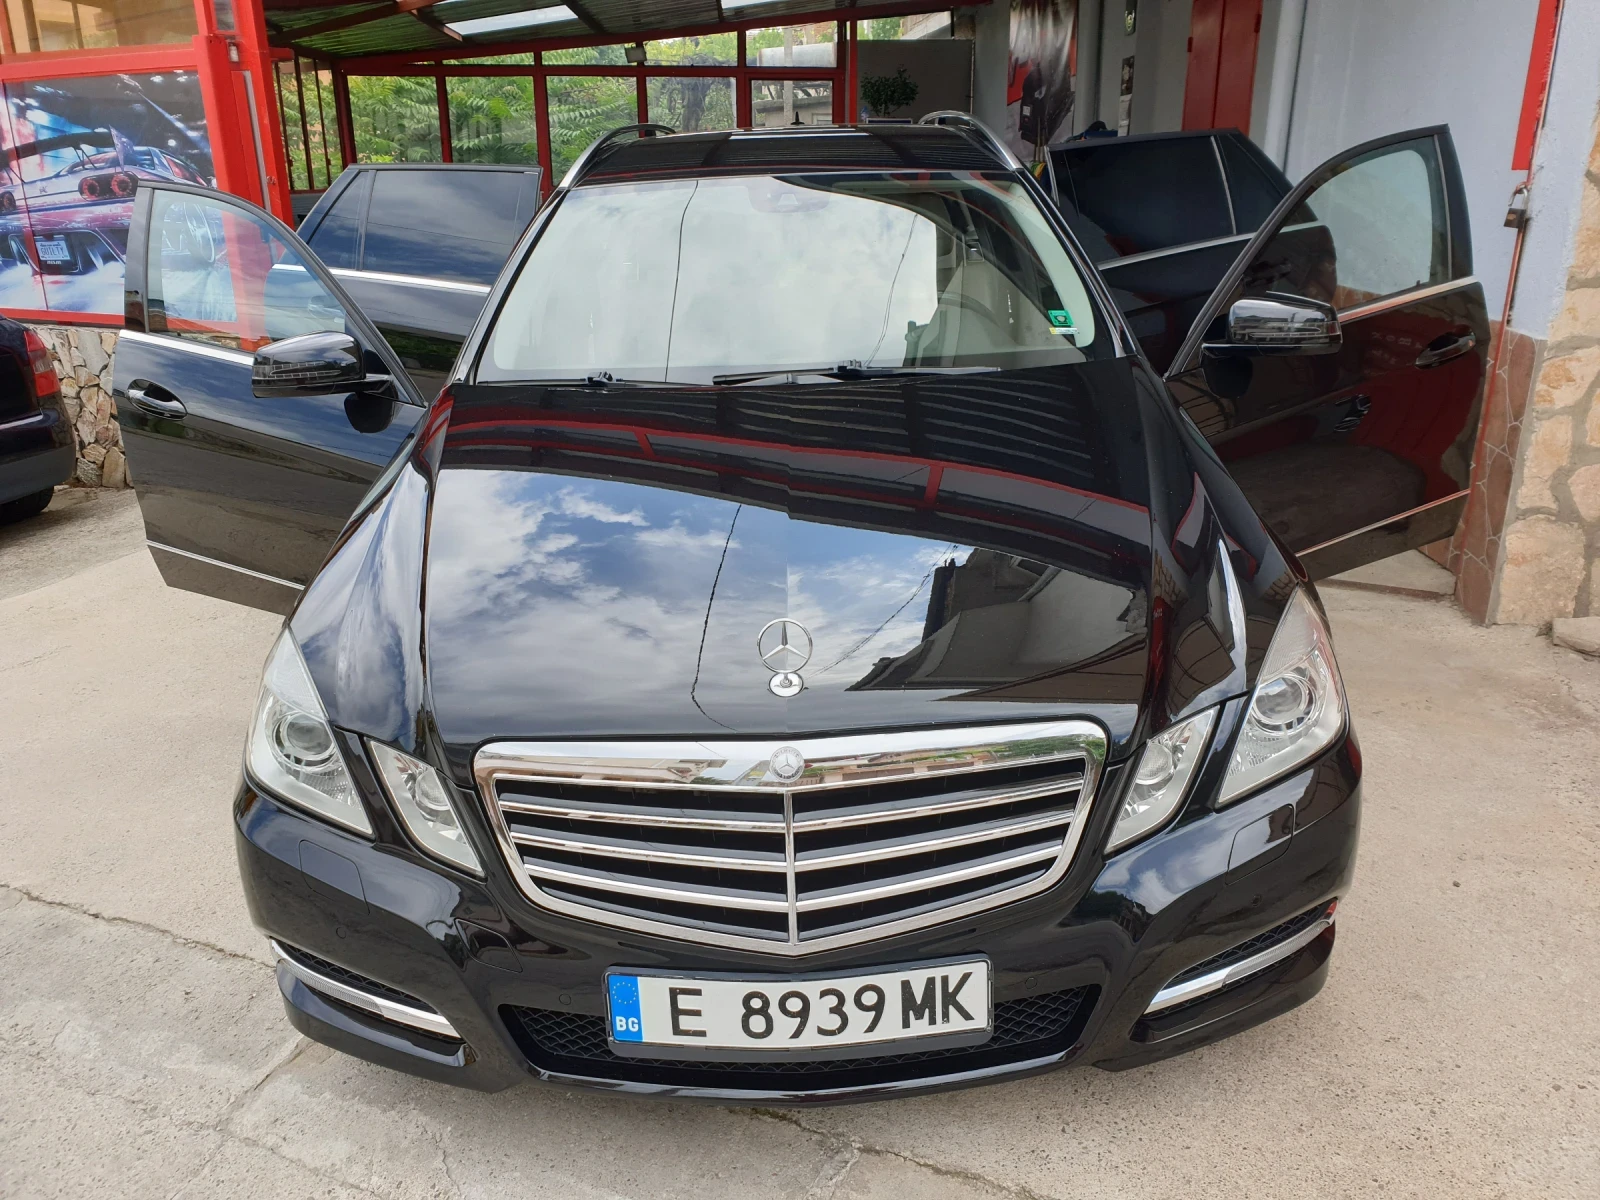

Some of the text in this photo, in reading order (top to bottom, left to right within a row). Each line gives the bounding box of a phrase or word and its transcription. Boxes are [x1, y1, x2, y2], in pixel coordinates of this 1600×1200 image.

[40, 246, 64, 256] GUILTY
[668, 971, 975, 1039] E 8939 MK
[615, 1016, 639, 1032] BG
